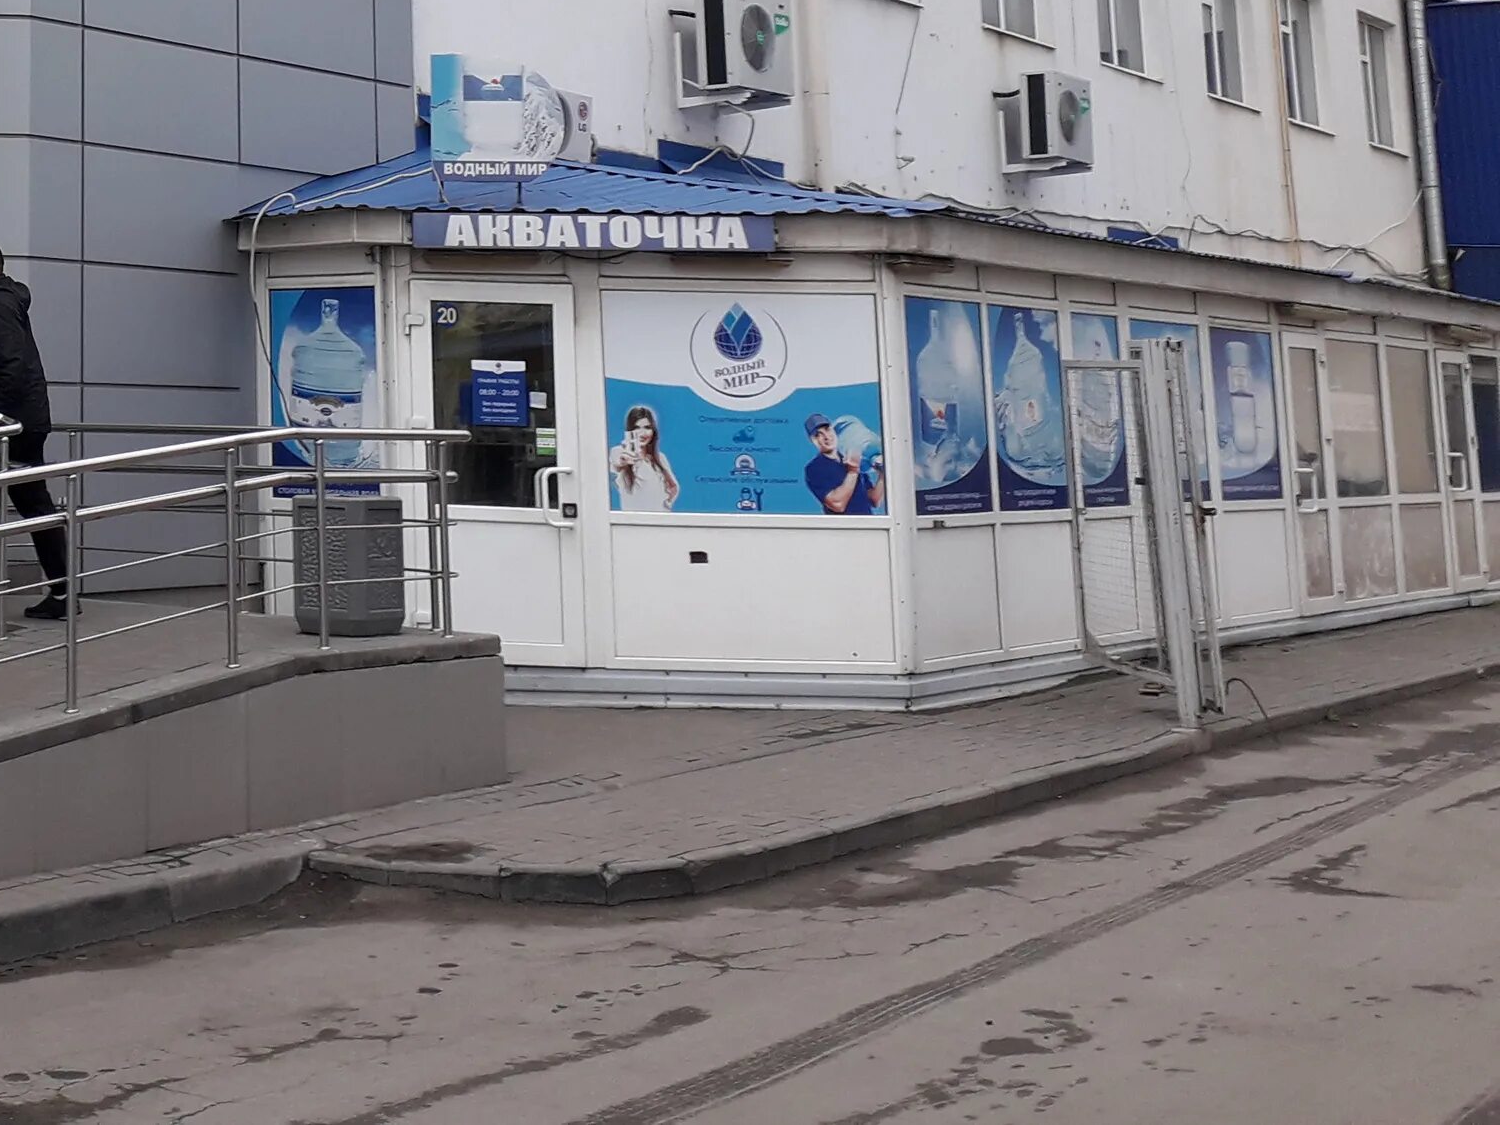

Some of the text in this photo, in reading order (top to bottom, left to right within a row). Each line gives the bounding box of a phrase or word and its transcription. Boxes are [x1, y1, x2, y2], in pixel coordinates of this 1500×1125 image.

[577, 122, 587, 134] LG
[443, 161, 548, 178] ВОДНЫЙ МИР
[443, 213, 749, 250] АКВАТОЧКА
[436, 307, 457, 324] 20
[714, 358, 766, 378] ВОДНЫЙ
[722, 371, 762, 390] МИР
